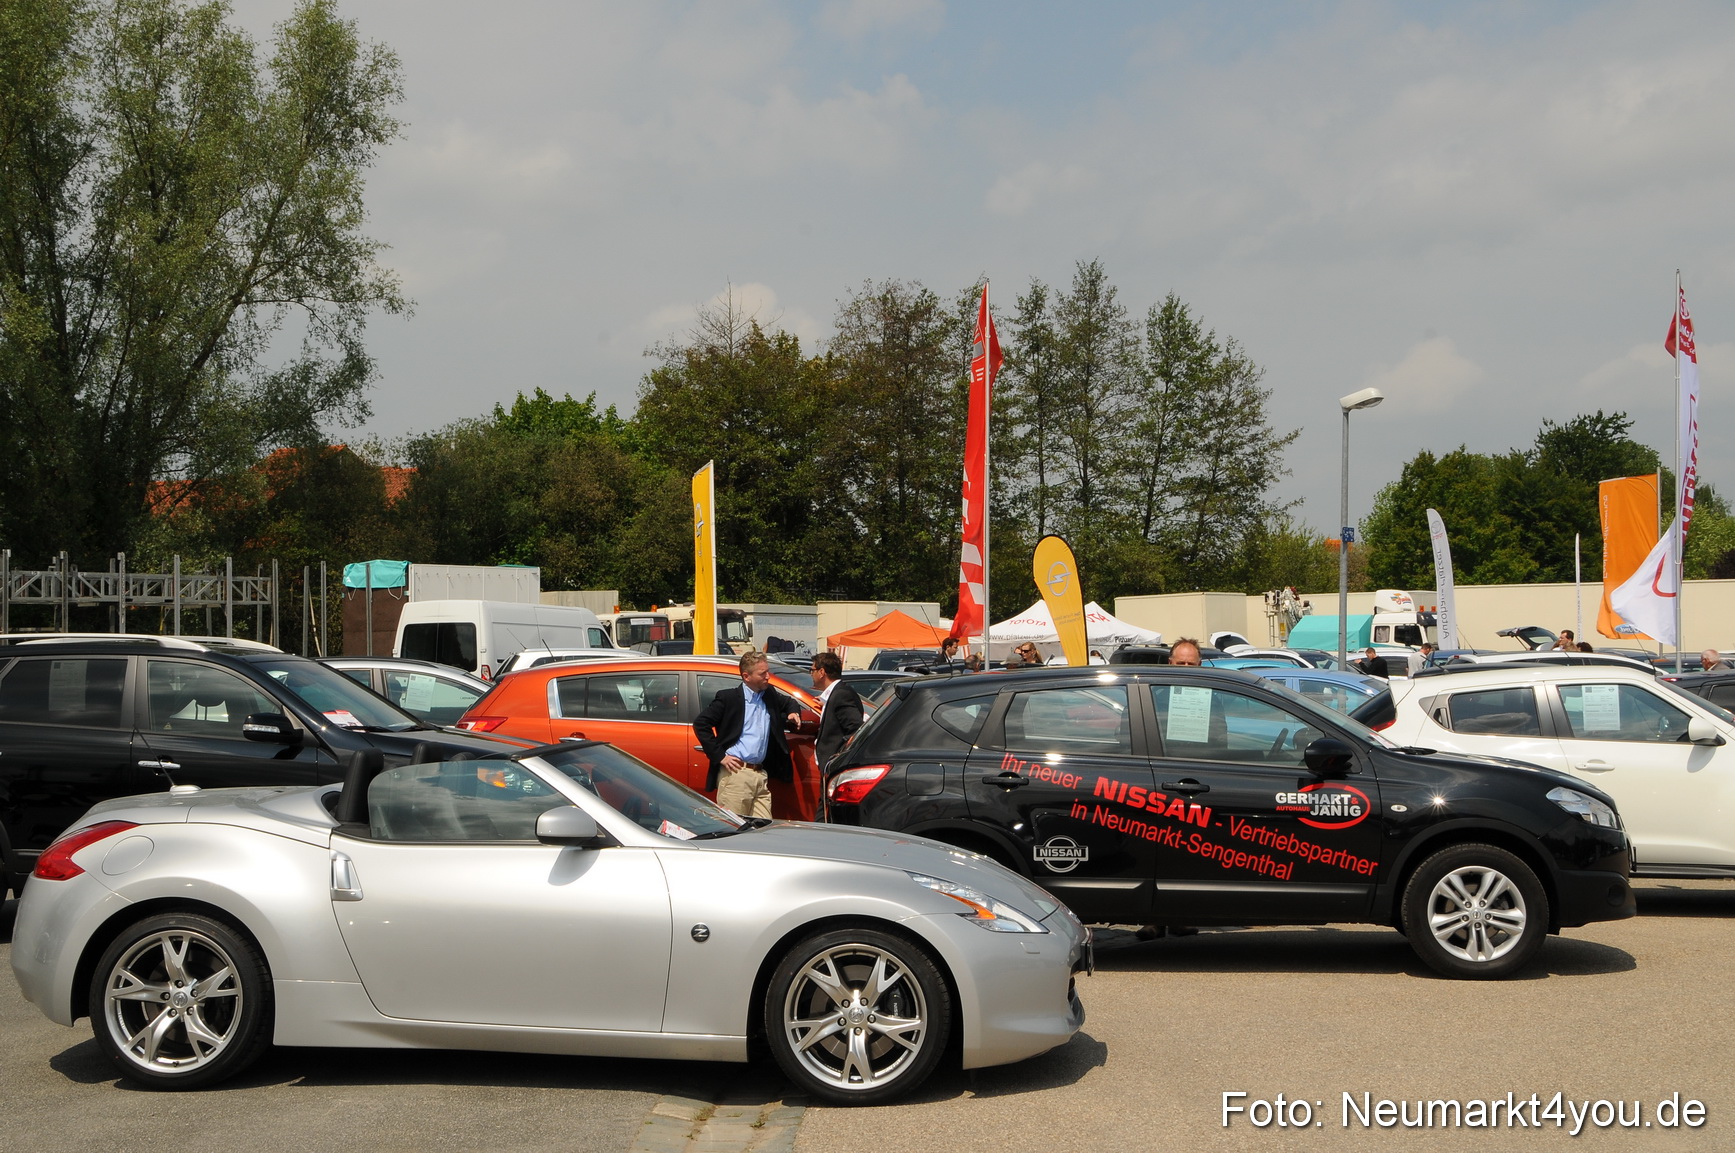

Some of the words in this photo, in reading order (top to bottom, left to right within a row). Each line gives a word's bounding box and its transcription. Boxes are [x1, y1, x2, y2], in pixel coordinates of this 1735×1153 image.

[1009, 618, 1047, 627] TOYOTA
[1275, 792, 1352, 805] GERHART
[1000, 752, 1027, 774] Ihr
[1028, 763, 1083, 790] neuer
[1093, 776, 1212, 828] NISSAN
[1229, 815, 1379, 877] Vertriebspartner
[1310, 805, 1362, 817] JÄNIG
[1070, 798, 1087, 821] in
[1091, 804, 1294, 881] Neumarkt-Sengenthal
[1039, 848, 1082, 857] NISSAN
